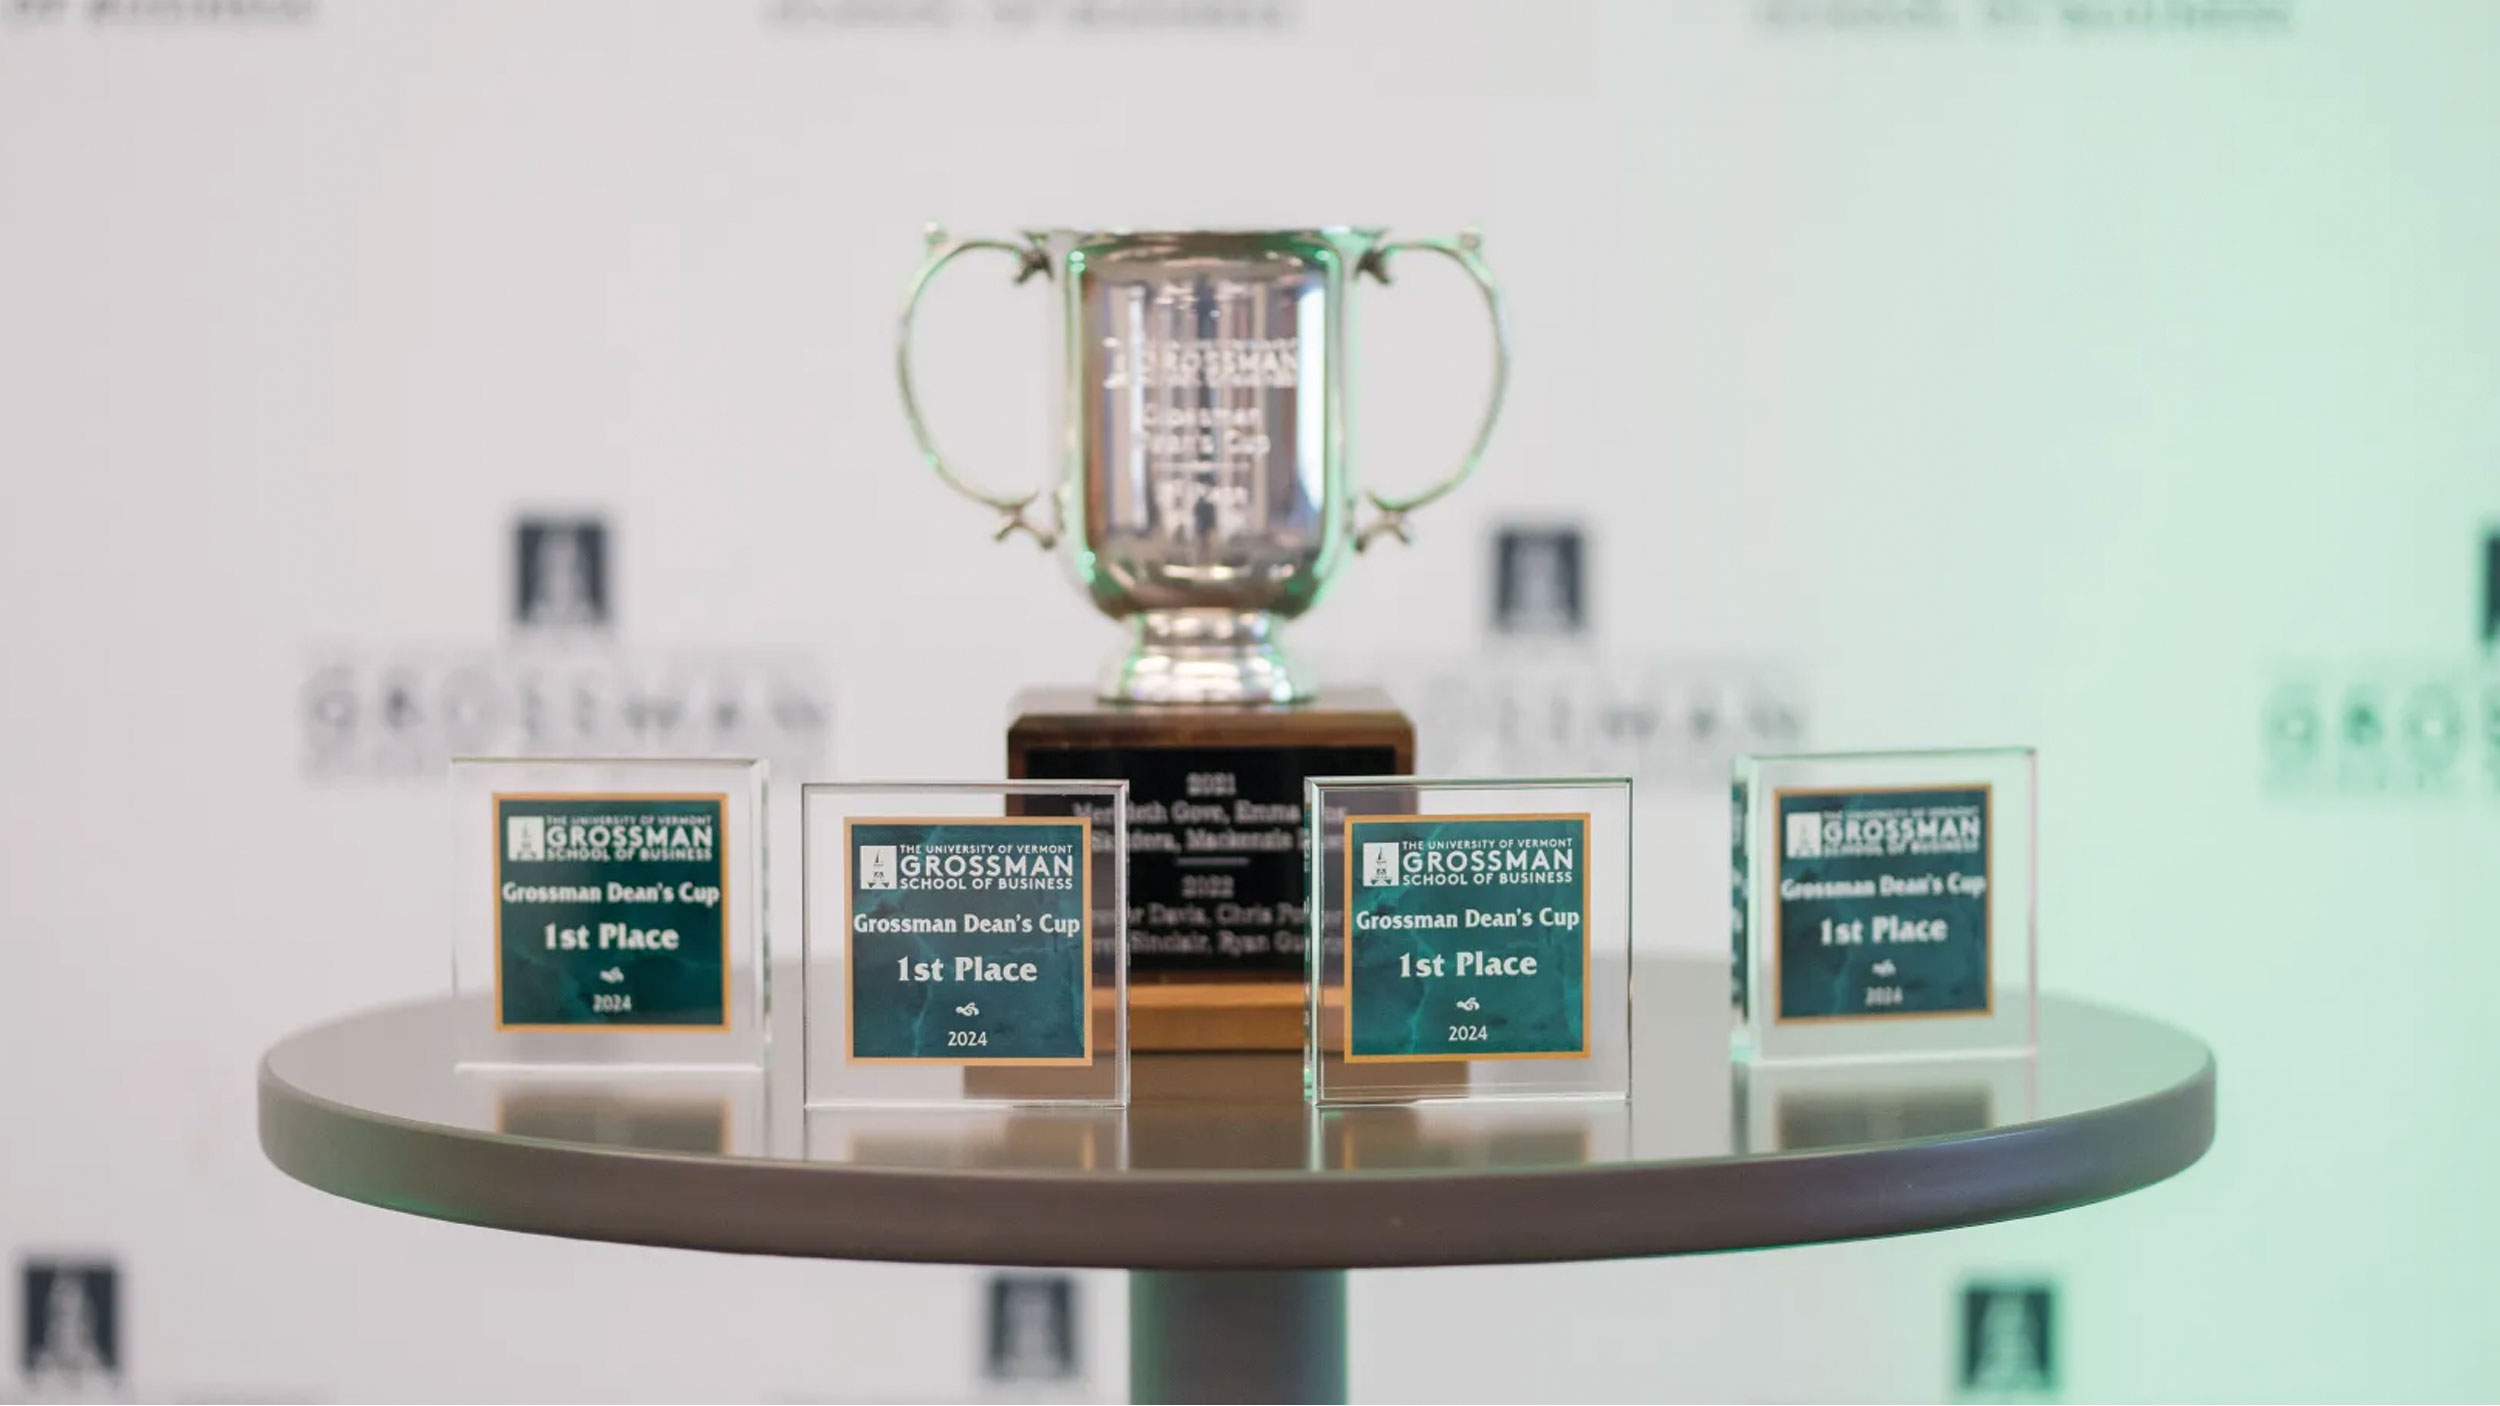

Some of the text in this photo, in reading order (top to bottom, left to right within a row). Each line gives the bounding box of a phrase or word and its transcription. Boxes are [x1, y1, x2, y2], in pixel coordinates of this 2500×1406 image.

[546, 815, 712, 826] THE UNIVERSITY OF VERMONT
[1823, 816, 1981, 842] GROSSMAN
[546, 825, 713, 848] GROSSMAN
[1402, 838, 1573, 850] THE UNIVERSITY OF VERMONT
[546, 848, 713, 862] SCHOOL OF BUSINESS
[900, 844, 1073, 855] THE UNIVERSITY OF VERMONT
[1402, 848, 1573, 873] GROSSMAN
[900, 854, 1073, 877] GROSSMAN
[900, 877, 1073, 890] SCHOOL OF BUSINESS
[1402, 871, 1573, 886] SCHOOL OF BUSINESS
[1780, 872, 1987, 900] Grossman Dean's Cup
[502, 882, 721, 908] Grossman Dean's Cup
[853, 913, 956, 933] Grossman
[963, 913, 1033, 933] Dean's
[1038, 913, 1080, 937] Cup
[1356, 910, 1458, 930] Grossman
[1465, 908, 1533, 928] Dean's
[1539, 907, 1580, 931] Cup
[1821, 915, 1948, 946] 1st Place
[544, 923, 680, 950] 1st Place
[897, 955, 1038, 982] 1st Place
[1399, 951, 1537, 978] 1st Place
[593, 994, 632, 1013] 2024
[947, 1031, 988, 1047] 2024
[1448, 1025, 1488, 1041] 2024
